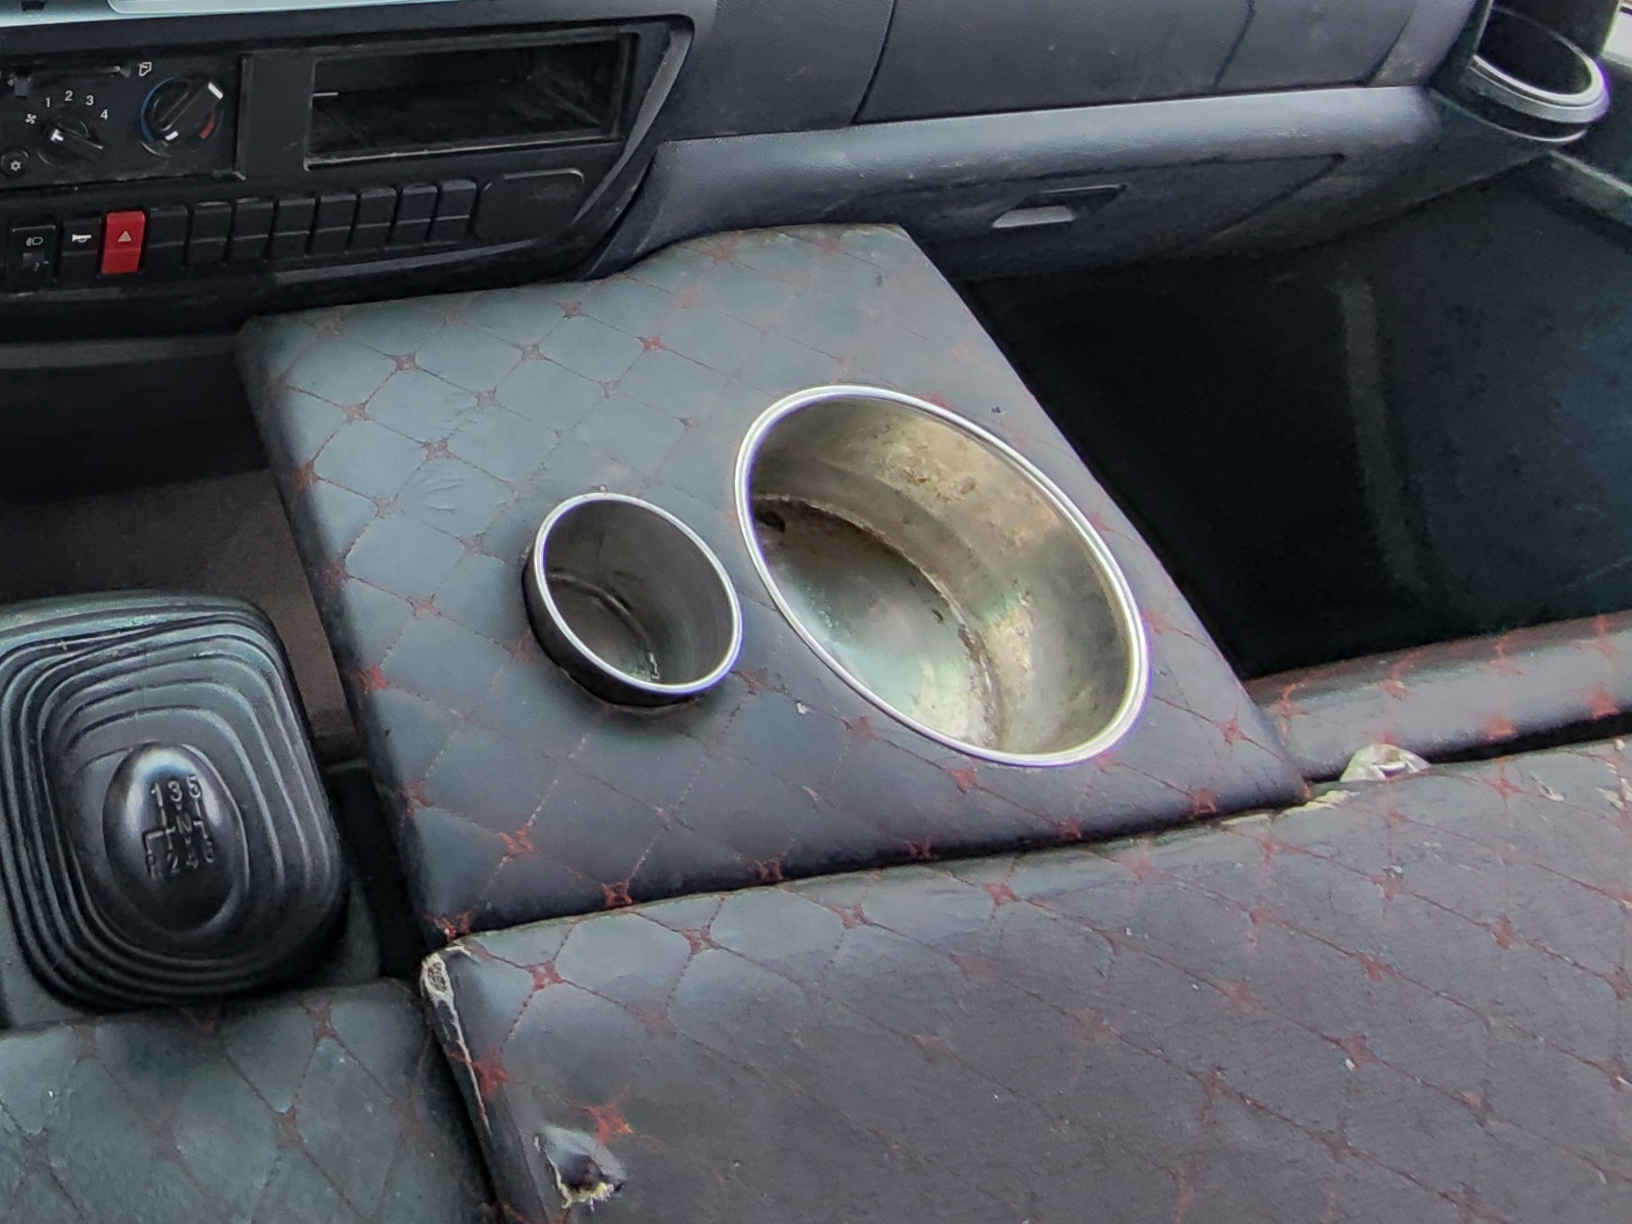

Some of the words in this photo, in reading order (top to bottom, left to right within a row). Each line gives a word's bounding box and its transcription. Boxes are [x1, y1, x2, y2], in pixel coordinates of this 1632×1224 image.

[45, 97, 51, 108] 1
[64, 90, 73, 101] 2
[85, 94, 94, 106] 3
[100, 108, 108, 120] 4
[151, 782, 163, 807] 1
[168, 780, 183, 802] 3
[187, 775, 201, 799] 5
[176, 812, 193, 834] N
